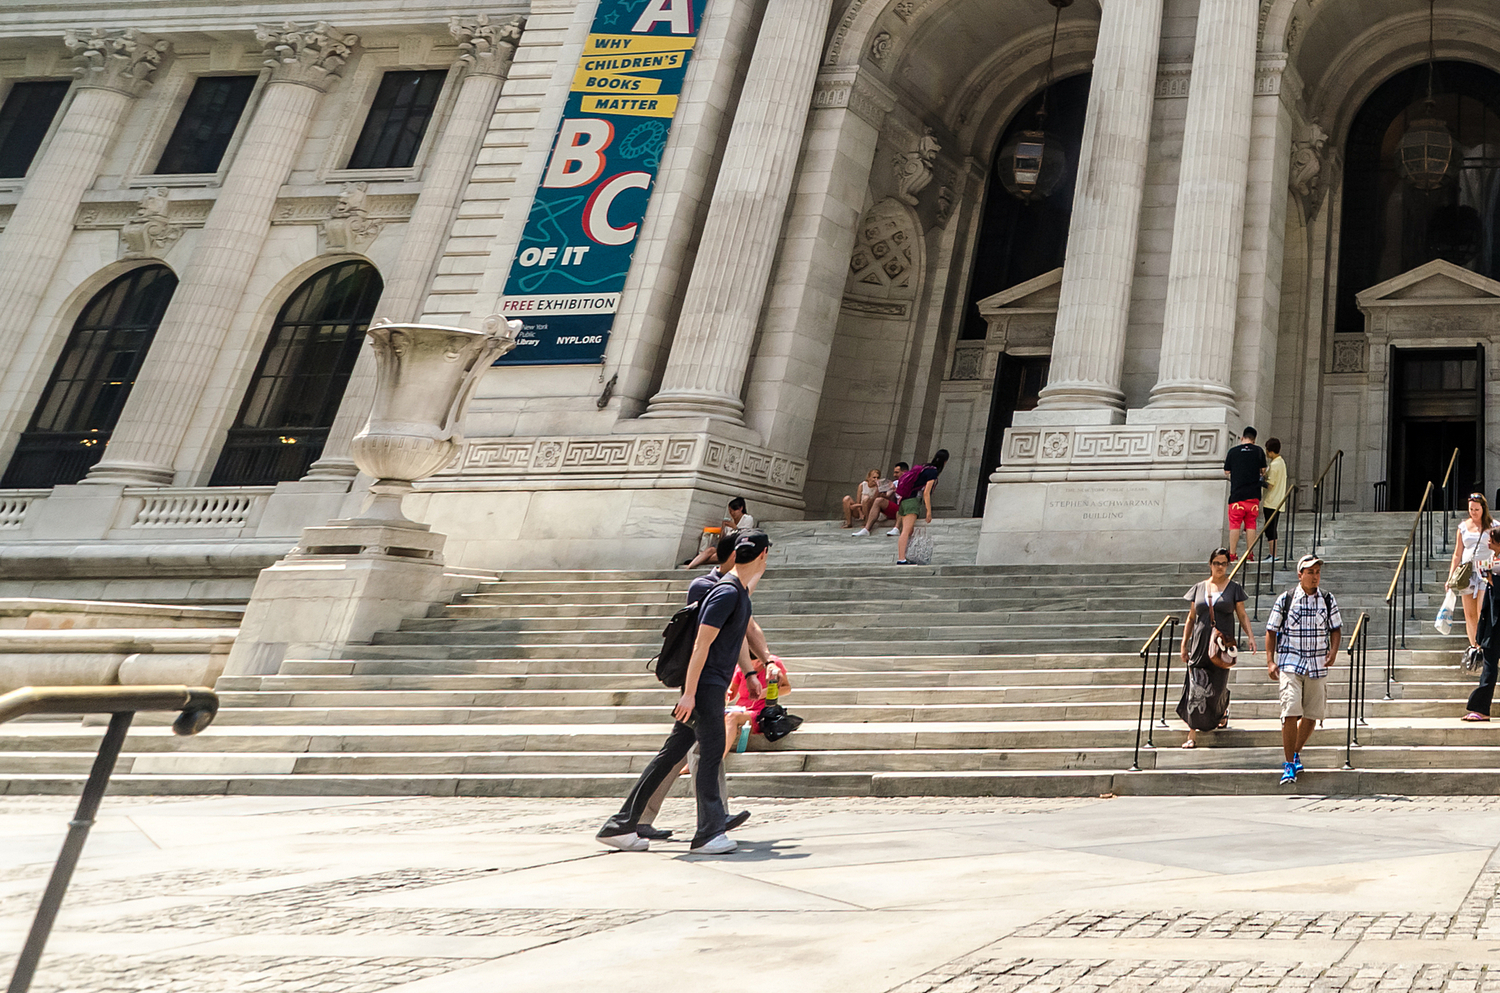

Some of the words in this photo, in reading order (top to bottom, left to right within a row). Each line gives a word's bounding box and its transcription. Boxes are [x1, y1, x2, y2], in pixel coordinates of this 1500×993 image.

[594, 38, 633, 50] WHY
[584, 53, 679, 72] CHILDREN'S
[585, 76, 642, 92] BOOKS
[594, 97, 659, 111] MATTER
[542, 118, 615, 188] B
[582, 170, 652, 246] C
[519, 247, 558, 267] OF
[561, 246, 590, 266] IT
[503, 300, 535, 311] FREE
[537, 298, 616, 310] EXHIBITION
[516, 338, 540, 347] Library
[556, 335, 603, 345] NYPL.ORG
[1049, 500, 1089, 508] STEPHEN
[1097, 499, 1160, 507] SCHWARZMAN
[1082, 512, 1124, 520] BUILDING
